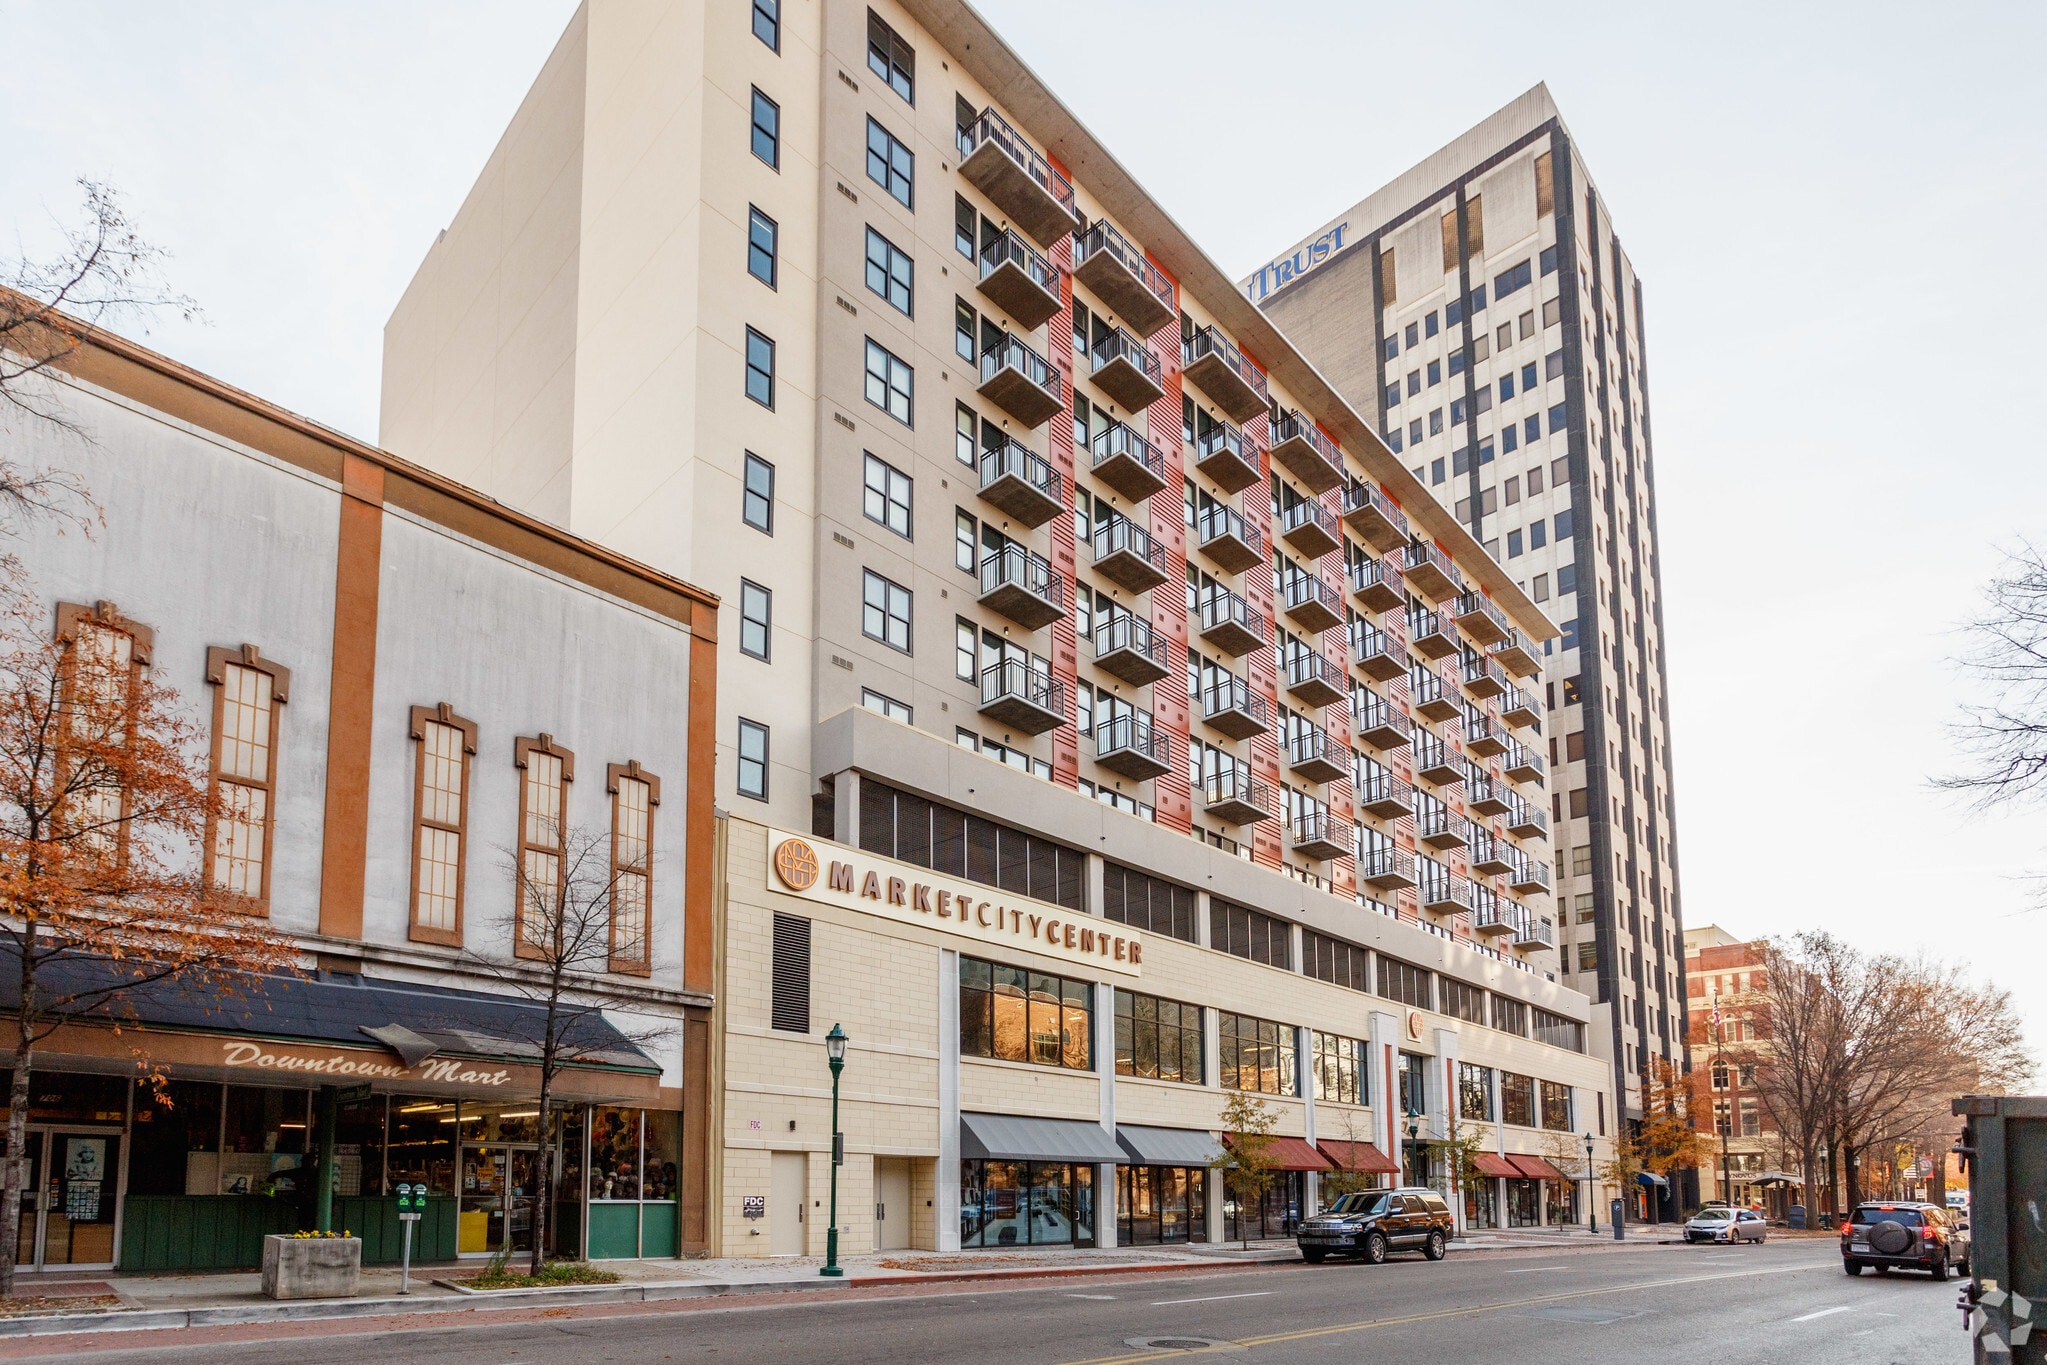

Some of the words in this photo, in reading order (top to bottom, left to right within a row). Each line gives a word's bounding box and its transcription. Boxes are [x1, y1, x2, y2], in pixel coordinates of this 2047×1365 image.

[223, 1042, 411, 1077] Downtown
[419, 1058, 511, 1086] Mart
[750, 1120, 761, 1129] FDC
[744, 1197, 764, 1206] FDC
